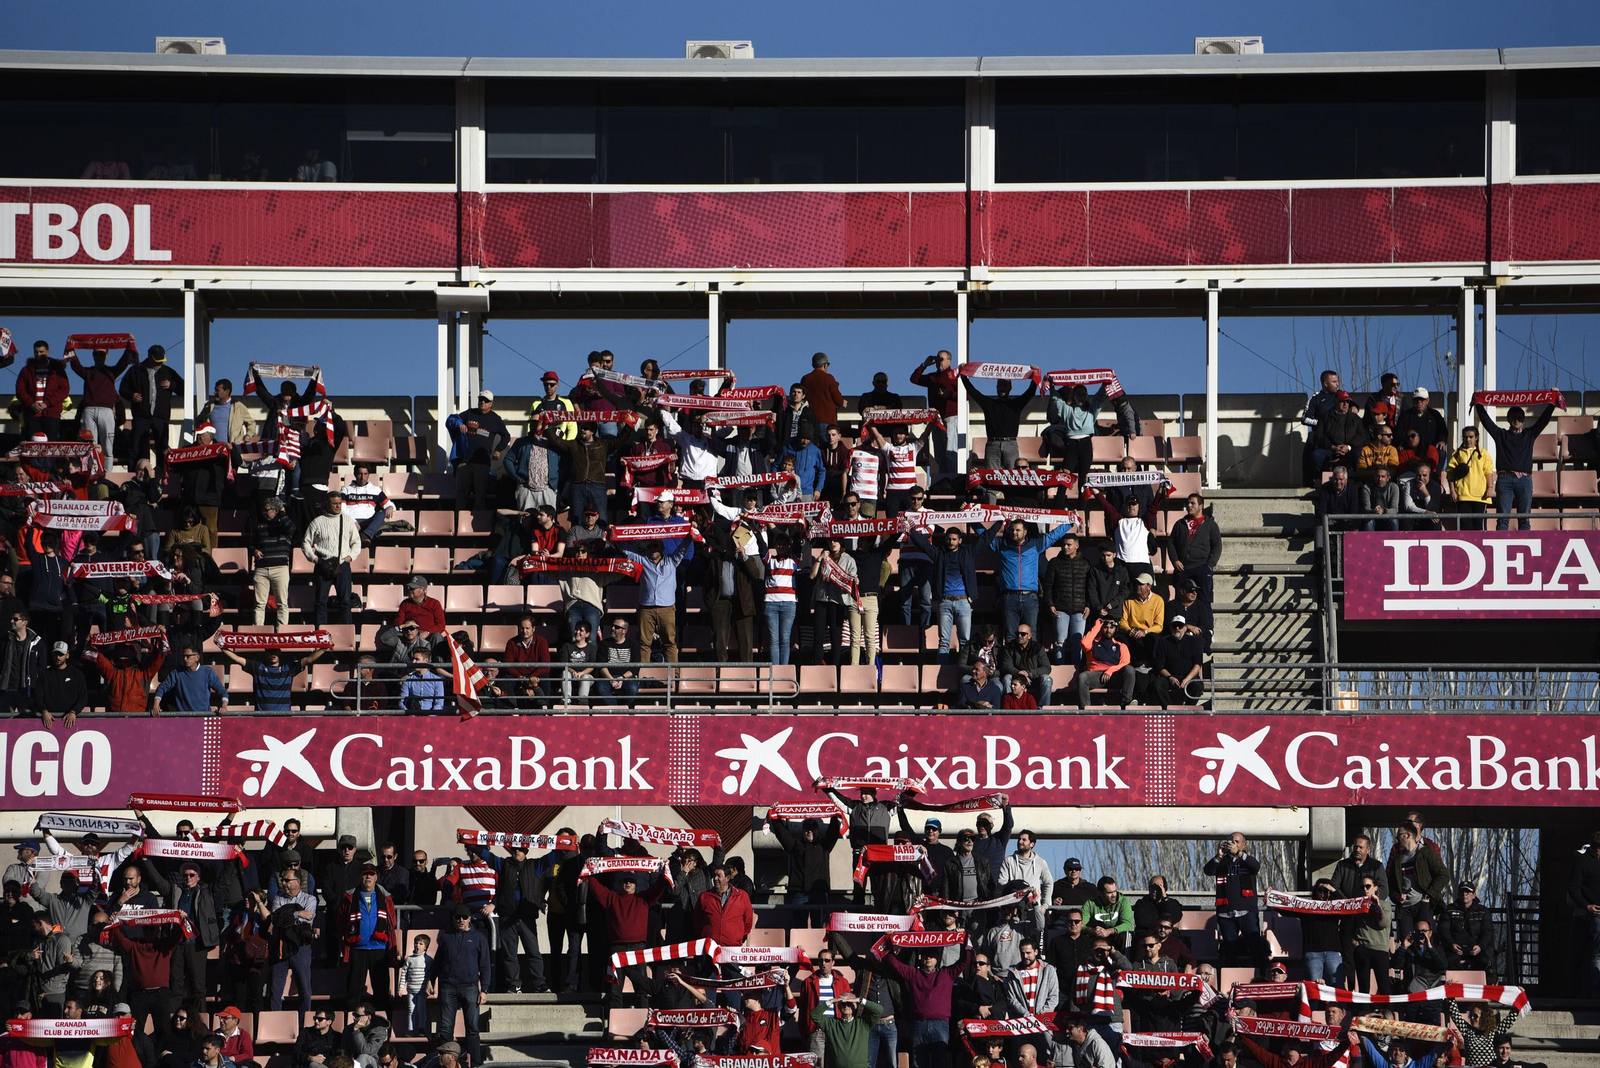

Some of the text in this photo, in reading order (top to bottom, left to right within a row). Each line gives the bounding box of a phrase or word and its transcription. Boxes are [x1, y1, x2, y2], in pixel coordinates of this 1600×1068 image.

[0, 202, 172, 261] TBOL
[720, 390, 764, 399] GRANADA
[1485, 393, 1552, 405] GRANADA C.F.
[546, 411, 618, 422] GRANADA C.F.
[718, 473, 784, 486] GRANADA C.F.
[1100, 474, 1156, 484] DERRIBAGIGANTES
[5, 482, 53, 491] GRANADA
[52, 503, 90, 511] GRANADA
[832, 521, 894, 534] GRANADA C.F.
[547, 557, 608, 566] GRANADA
[83, 562, 152, 573] VOLVEREMOS
[224, 635, 329, 644] GRANADA C.F.
[0, 730, 112, 797] GO
[330, 732, 654, 791] CaixaBank
[806, 732, 1130, 790] CaixaBank
[500, 834, 517, 842] NEVER
[190, 849, 215, 858] FÚTBOL
[877, 922, 900, 930] FÚTBOL
[892, 933, 964, 945] GRANADA C.F.
[745, 975, 765, 986] Fútbol
[1125, 973, 1199, 987] GRANADA C.F.
[657, 1012, 729, 1023] Granada Club de Fútbol
[989, 1020, 1040, 1031] GRANADA
[1277, 1022, 1285, 1032] de
[1287, 1024, 1301, 1034] Club
[74, 1028, 99, 1036] FÚTBOL
[720, 1056, 792, 1068] GRANADA C.F.
